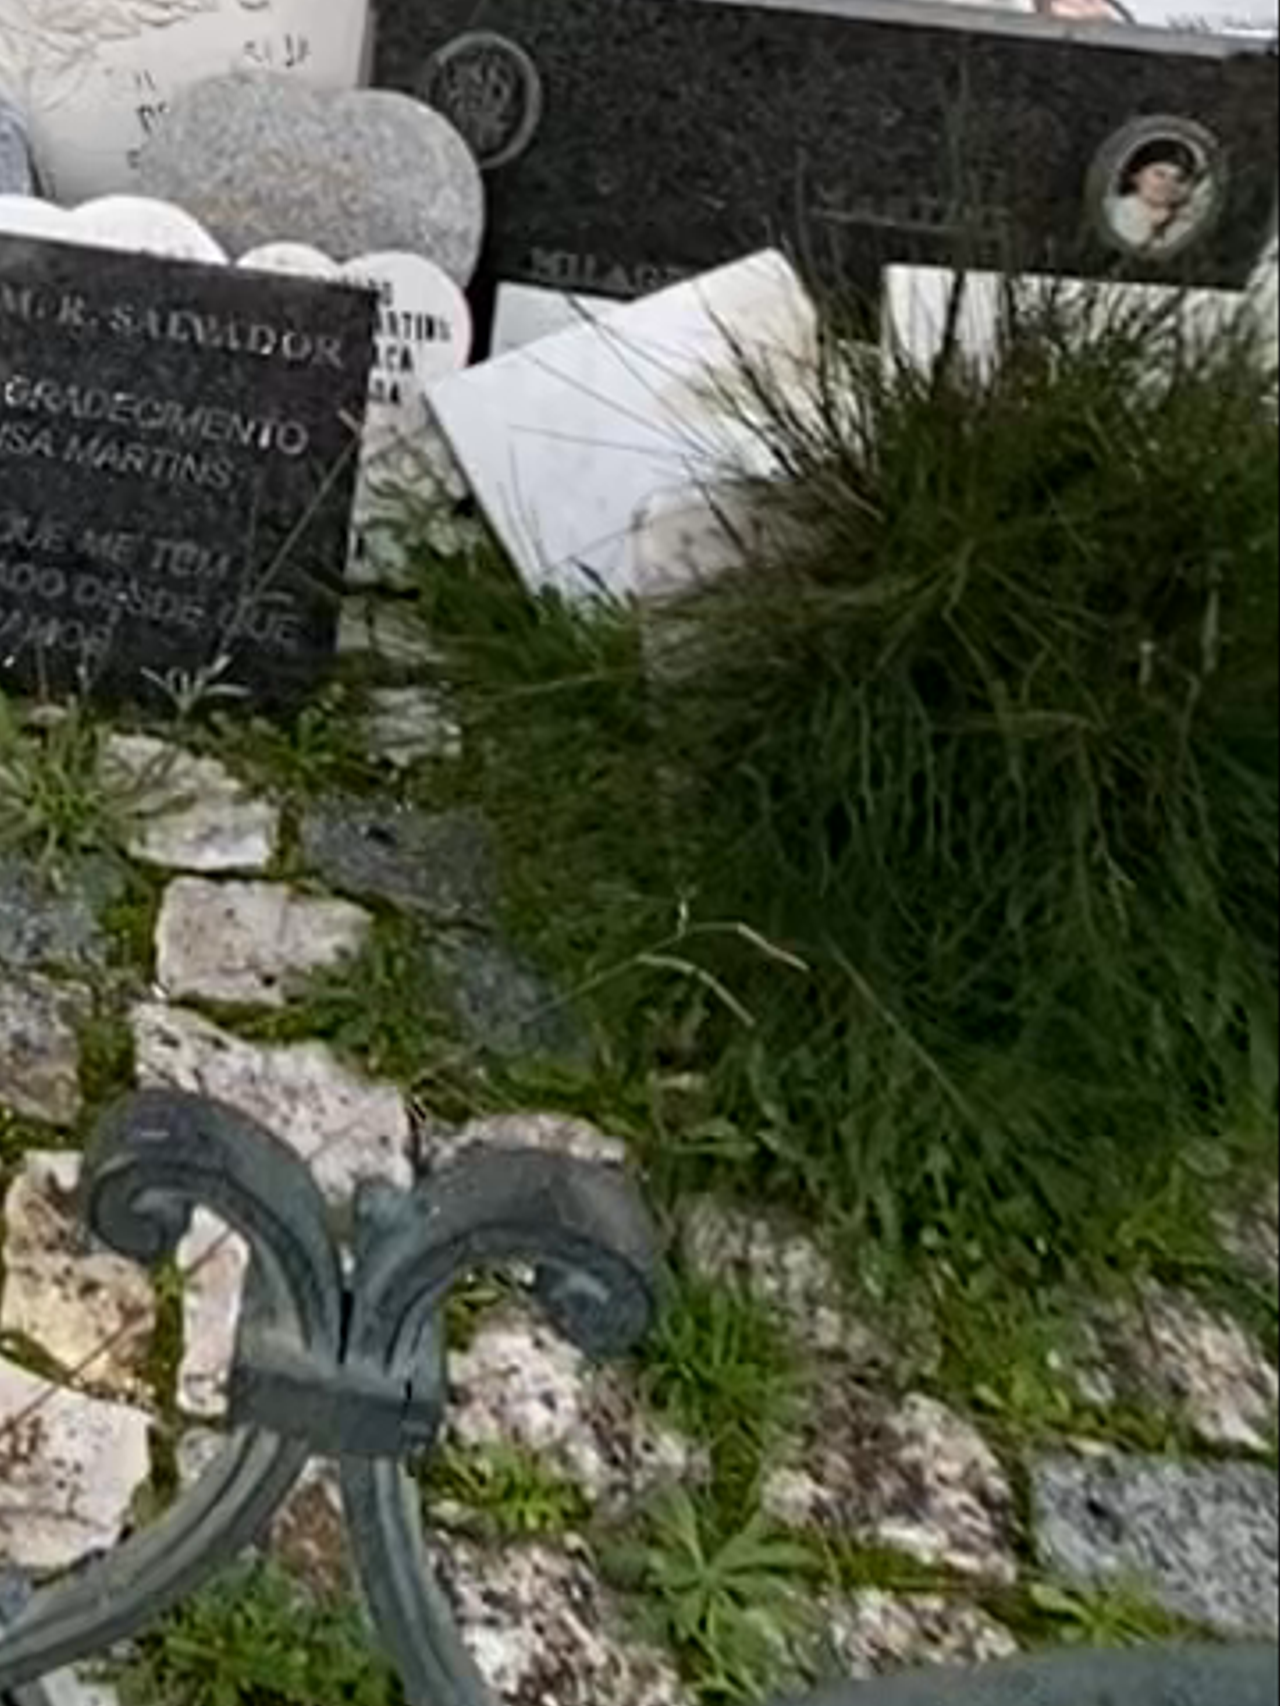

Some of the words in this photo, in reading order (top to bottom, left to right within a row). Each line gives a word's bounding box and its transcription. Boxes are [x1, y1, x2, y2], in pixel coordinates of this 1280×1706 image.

[111, 301, 345, 368] SALVADOR
[63, 434, 235, 488] MARTINS
[80, 526, 134, 563] ME
